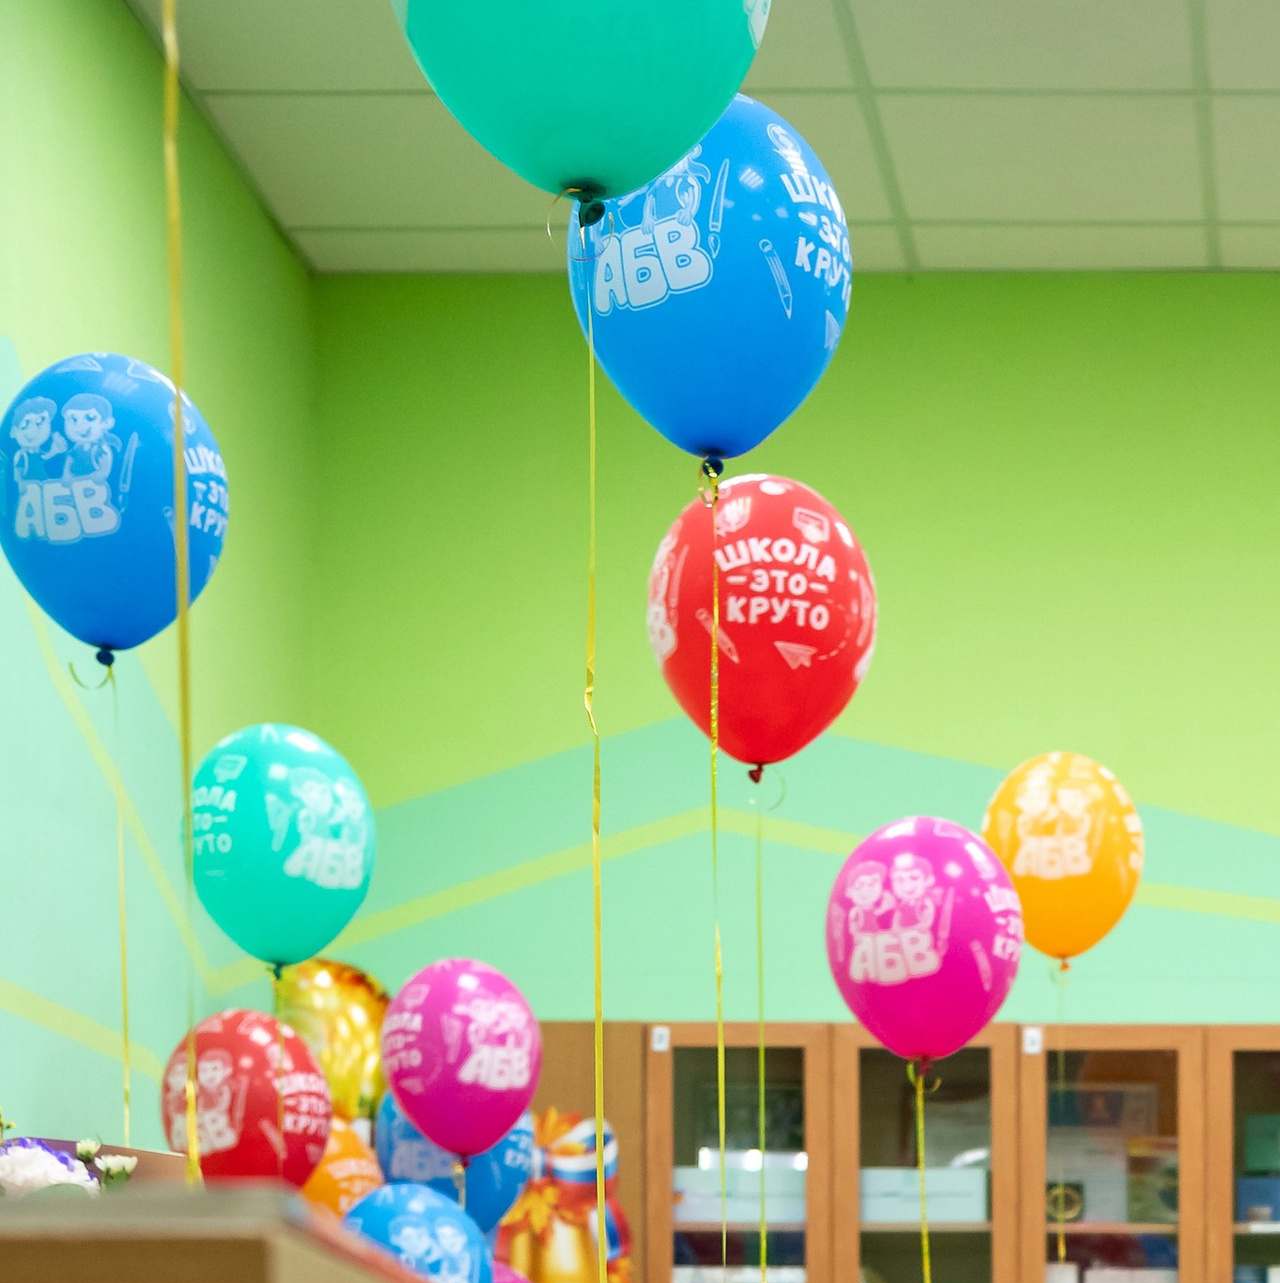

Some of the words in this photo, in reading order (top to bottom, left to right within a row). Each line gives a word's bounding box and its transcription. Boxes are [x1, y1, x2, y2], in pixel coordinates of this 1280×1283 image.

[594, 217, 714, 317] АБВ
[795, 236, 852, 312] КРУТ
[14, 480, 121, 545] АБВ
[714, 537, 835, 582] ШКОЛА
[727, 596, 829, 631] КРУТО
[282, 836, 364, 891] АБВ
[1012, 835, 1092, 880] АБВ
[850, 928, 943, 984] АБВ
[458, 1044, 531, 1091] АБВ
